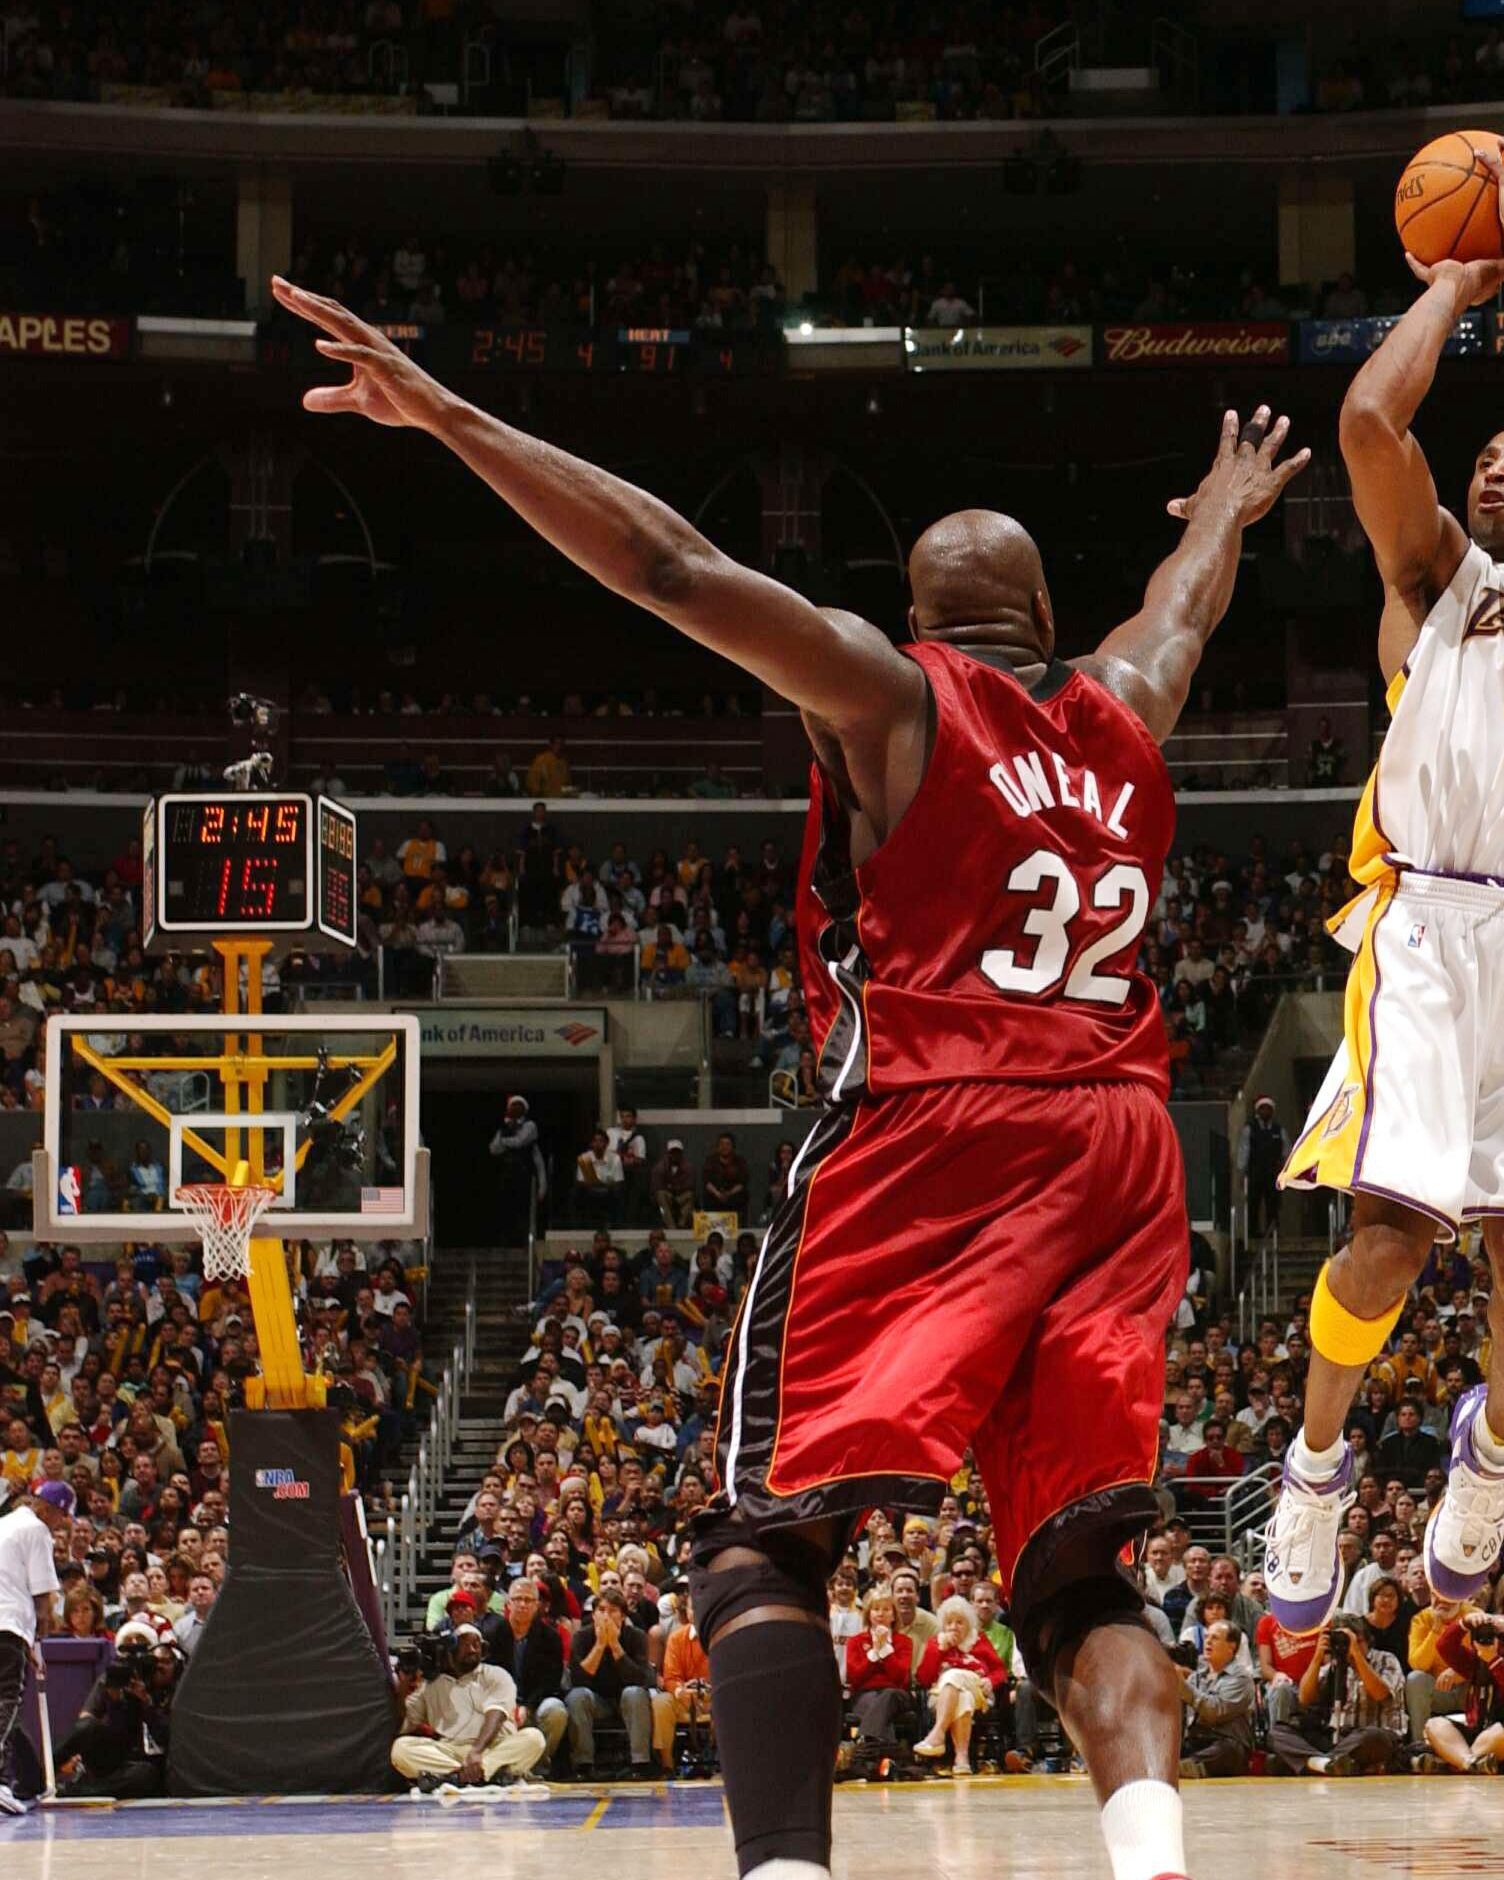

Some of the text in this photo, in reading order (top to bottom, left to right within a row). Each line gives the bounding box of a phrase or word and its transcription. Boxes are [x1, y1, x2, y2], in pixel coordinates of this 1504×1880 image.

[472, 330, 547, 364] 2:45
[972, 340, 1041, 356] America
[1104, 329, 1288, 362] Budweiser
[989, 750, 1136, 841] ONEAL
[201, 806, 299, 843] 2:45
[217, 857, 277, 916] 15
[979, 849, 1150, 1005] 32
[447, 1024, 466, 1043] of
[470, 1024, 545, 1043] America
